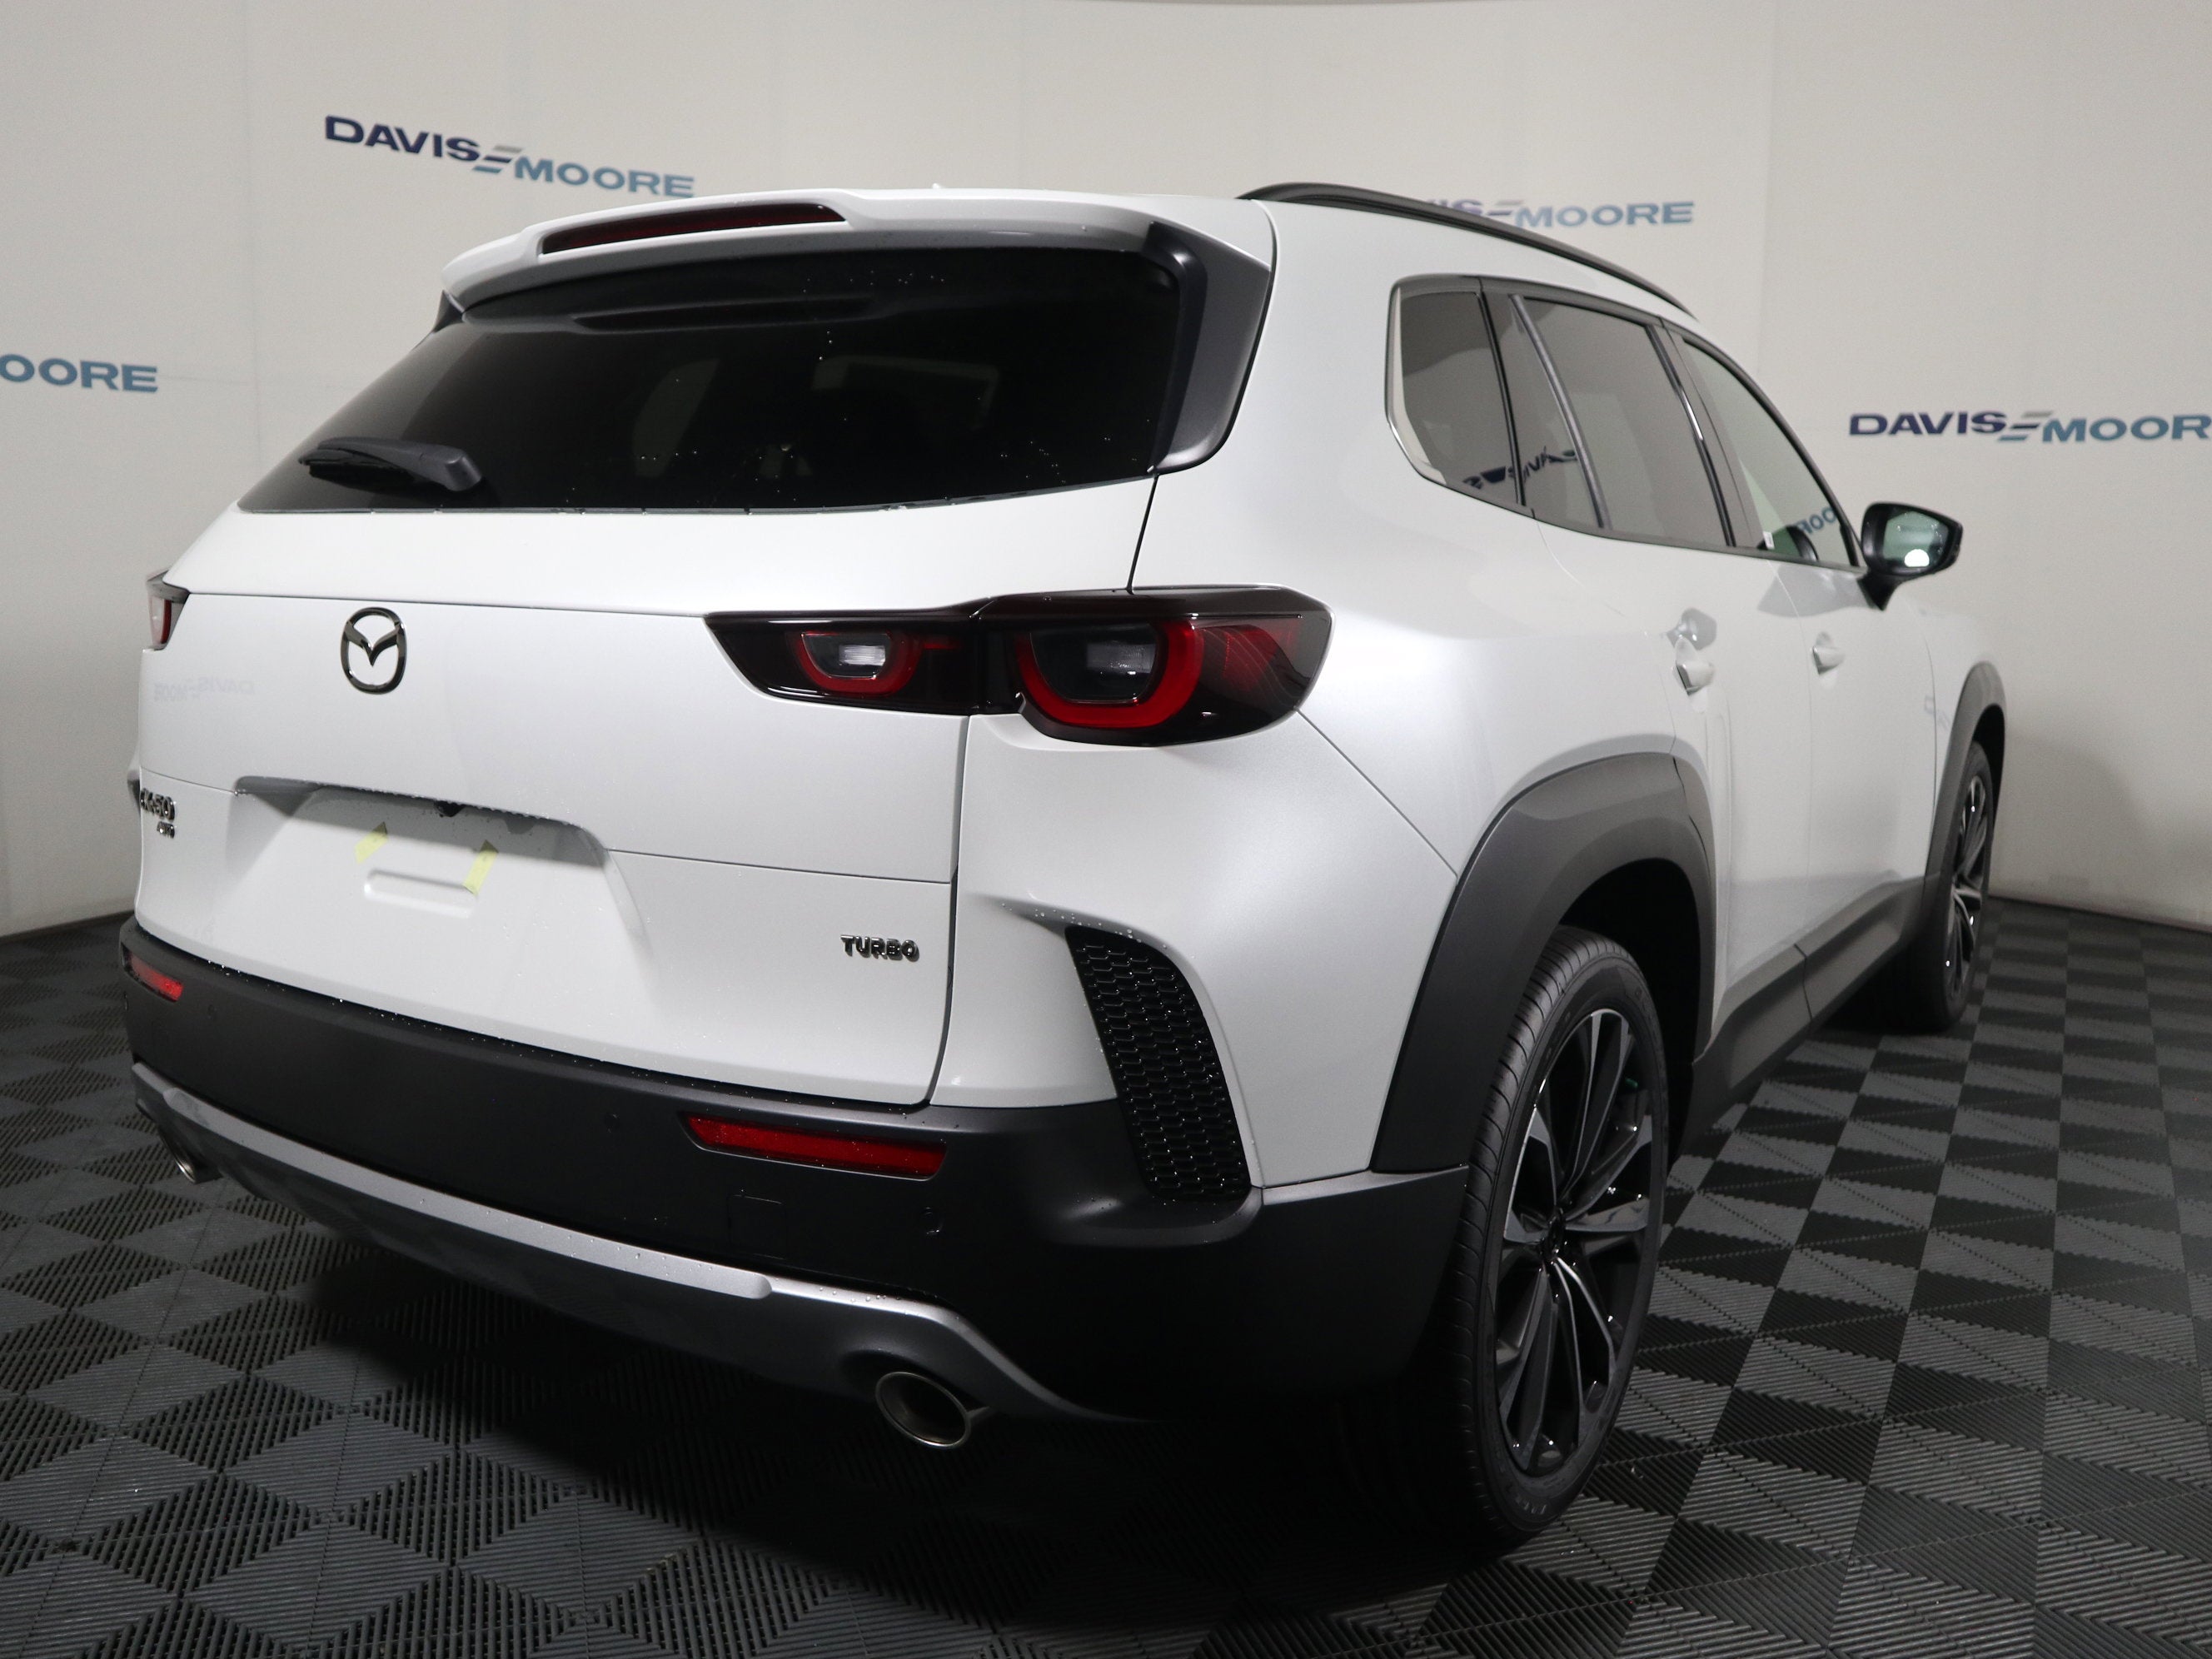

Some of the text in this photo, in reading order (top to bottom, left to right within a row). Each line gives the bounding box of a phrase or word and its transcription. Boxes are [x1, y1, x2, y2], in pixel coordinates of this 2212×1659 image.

[325, 114, 695, 199] DAVIS MOORE
[1515, 200, 1695, 228] MOORE
[1848, 411, 2008, 436] DAVIS
[839, 934, 920, 963] TURBO
